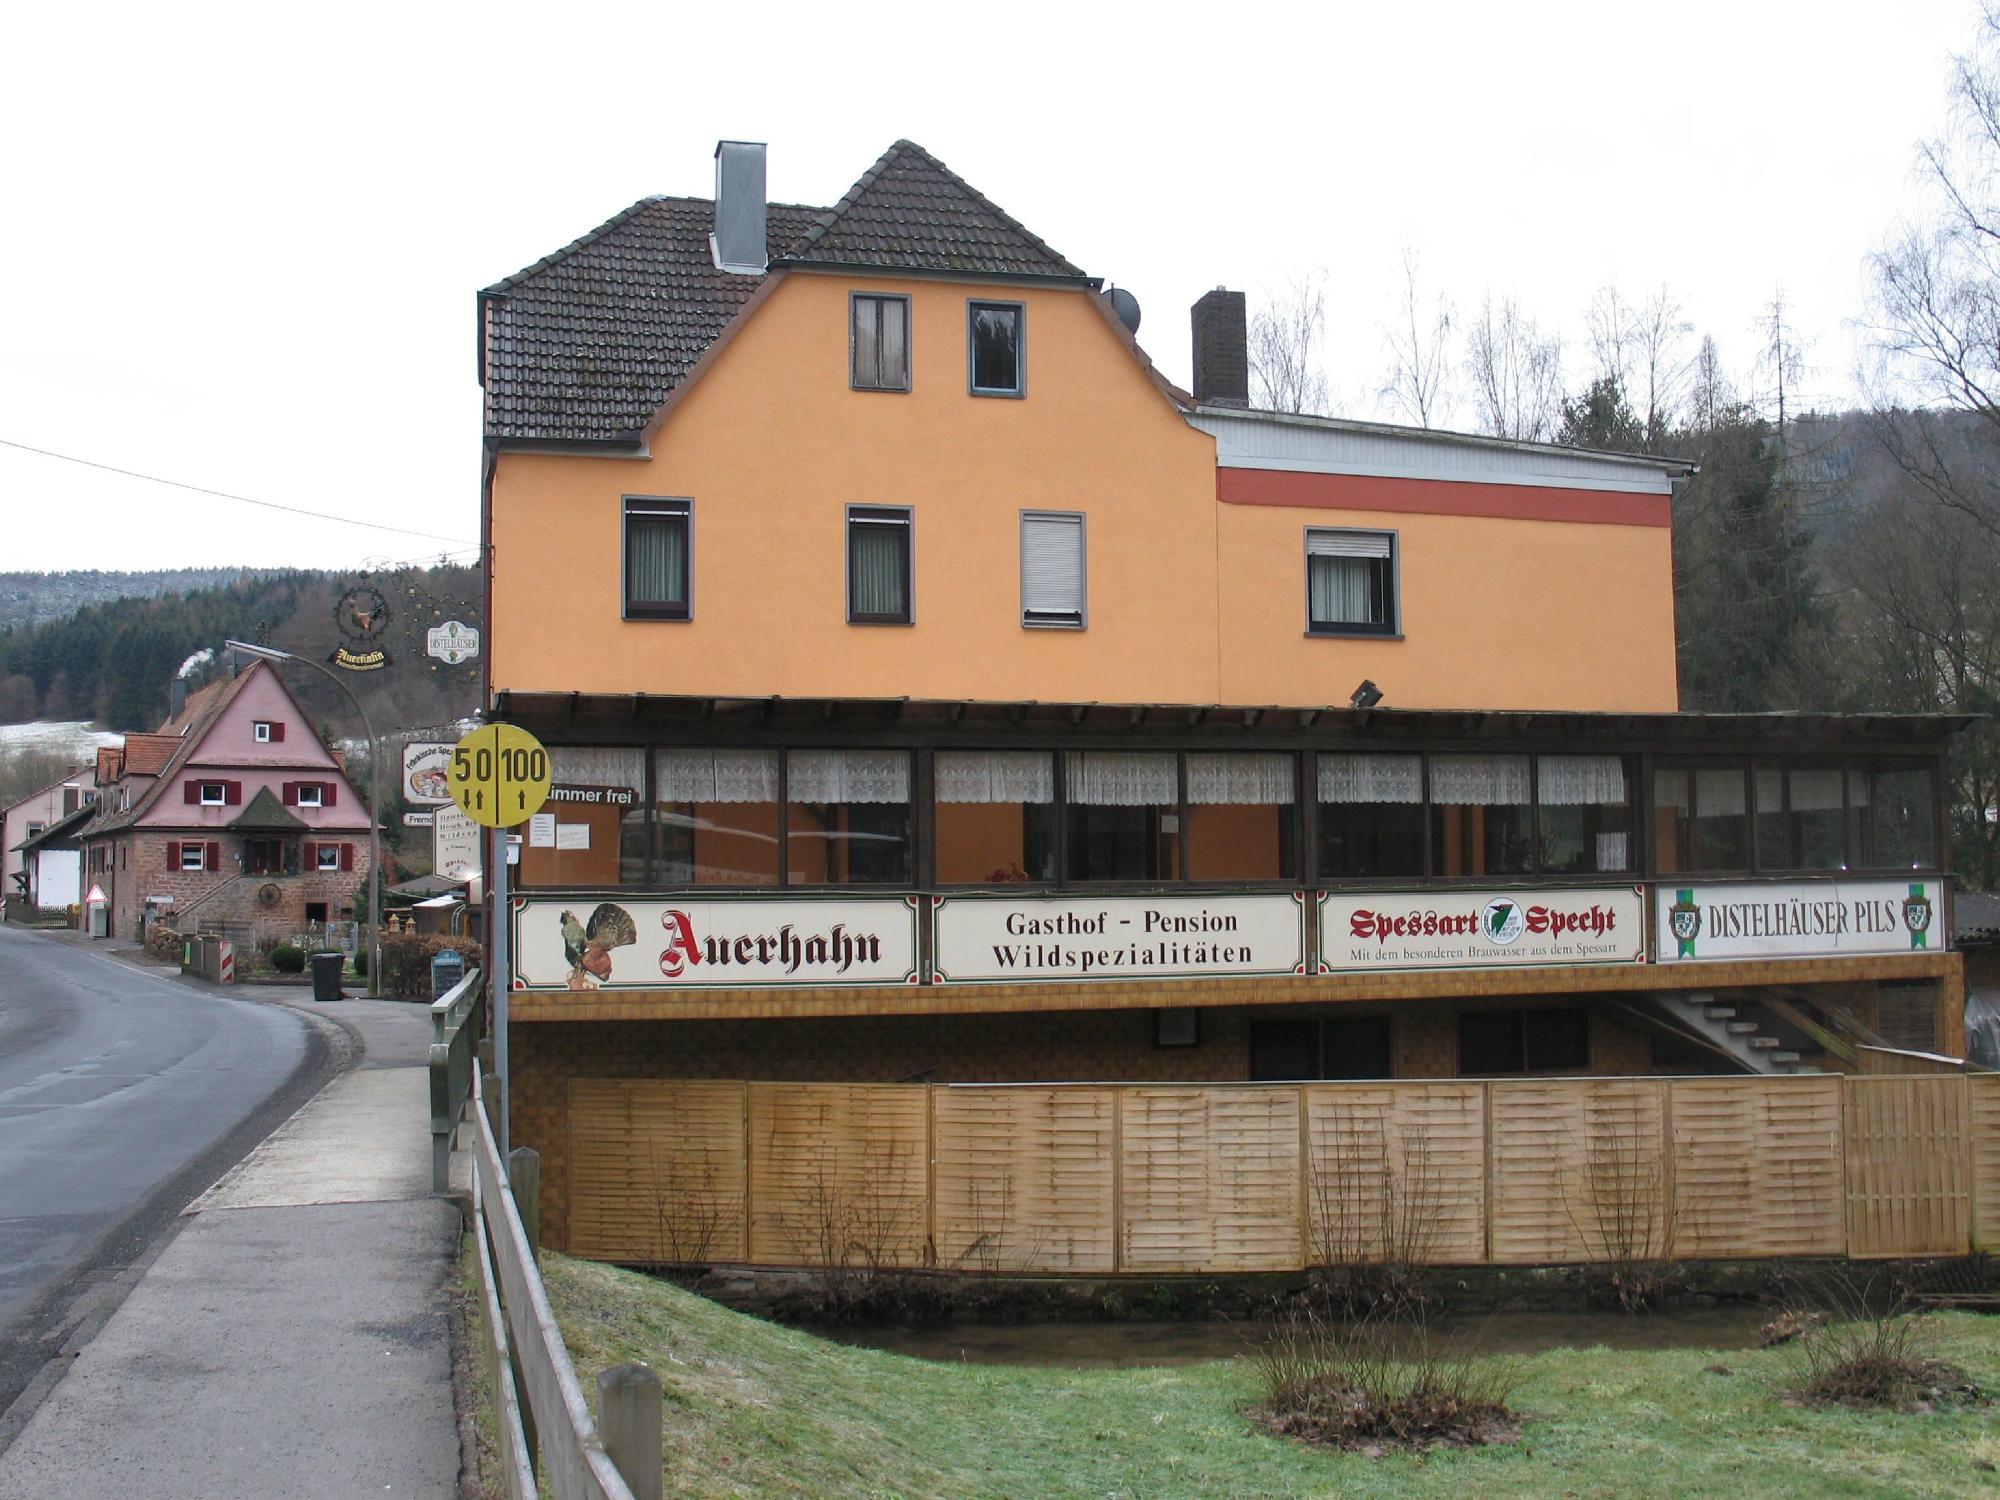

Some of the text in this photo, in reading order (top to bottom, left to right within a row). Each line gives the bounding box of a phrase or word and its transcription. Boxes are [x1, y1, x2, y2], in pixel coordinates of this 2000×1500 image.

[438, 746, 454, 756] Spe
[455, 748, 546, 782] 50 100
[606, 789, 632, 804] frei
[1005, 911, 1108, 936] Gasthof
[1143, 910, 1239, 934] Pension
[1350, 905, 1616, 945] Spessart Specht
[1709, 898, 1897, 938] DISTELHÄUSER PILS
[658, 909, 882, 979] Auerhahn
[992, 942, 1253, 972] Wildspezialitäten
[1350, 942, 1617, 961] Mit dem besonderen Brauwasser aus dem Spessart
